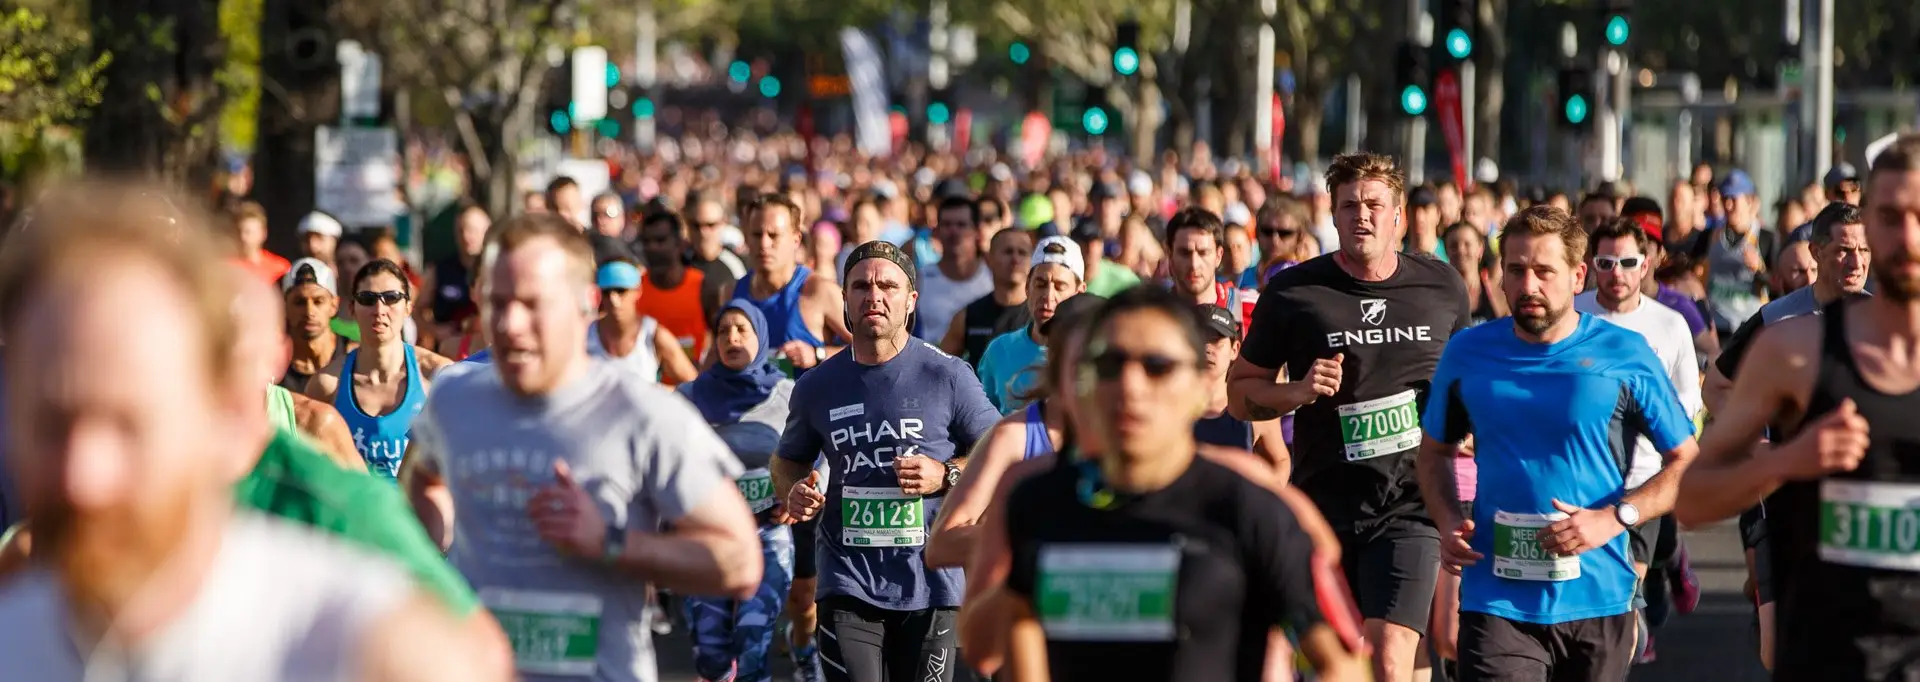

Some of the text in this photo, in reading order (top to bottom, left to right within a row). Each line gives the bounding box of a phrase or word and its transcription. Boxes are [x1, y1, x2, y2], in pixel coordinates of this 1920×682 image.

[1326, 325, 1432, 348] ENGINE
[830, 418, 924, 451] PHAR
[1349, 405, 1413, 440] 27000
[849, 500, 916, 526] 26123
